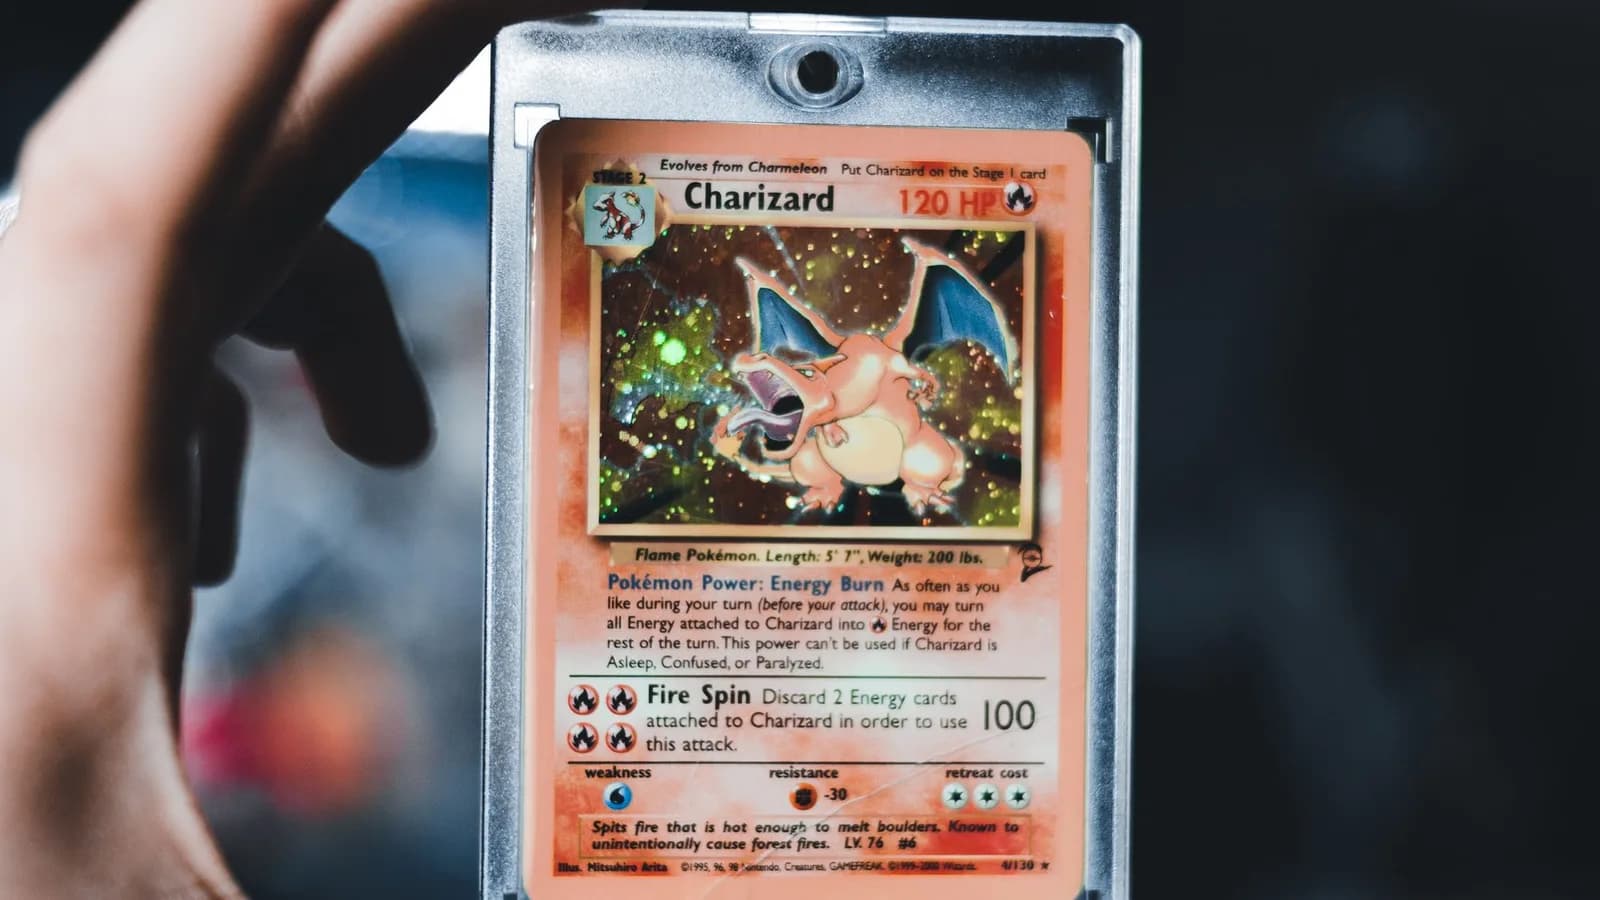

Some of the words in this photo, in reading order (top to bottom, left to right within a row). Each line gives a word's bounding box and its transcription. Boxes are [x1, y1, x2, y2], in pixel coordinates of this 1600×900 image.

[660, 159, 708, 173] Evolves
[712, 159, 743, 175] from
[748, 161, 827, 175] Charmeleon
[842, 164, 862, 176] Put
[866, 164, 924, 178] Charizard
[929, 169, 945, 178] on
[949, 165, 968, 179] the
[972, 167, 1004, 182] Stage
[1020, 168, 1046, 180] card
[592, 171, 633, 184] STAGE
[637, 172, 647, 184] 2
[684, 182, 834, 212] Charizard
[900, 190, 948, 216] 120
[960, 190, 996, 217] HP
[636, 548, 681, 563] Flame
[686, 548, 760, 563] Pokémon.
[765, 548, 820, 567] Length:
[868, 550, 922, 567] Weight:
[927, 550, 953, 565] 200
[958, 551, 983, 565] lbs.
[608, 574, 693, 591] Pokémon
[702, 575, 764, 591] Power:
[771, 576, 832, 596] Energy
[841, 576, 884, 592] Burn
[892, 581, 910, 593] As
[915, 580, 952, 594] often
[956, 584, 971, 594] as
[975, 585, 1000, 598] you
[608, 597, 631, 610] like
[636, 597, 681, 614] during
[686, 601, 717, 615] your
[723, 600, 752, 610] turn
[758, 597, 803, 615] (before
[807, 602, 835, 615] your
[840, 598, 889, 615] attack),
[893, 602, 918, 617] you
[922, 603, 949, 617] may
[956, 600, 984, 612] turn
[607, 617, 621, 630] all
[628, 618, 675, 634] Energy
[680, 617, 740, 630] attached
[745, 620, 759, 630] to
[765, 618, 833, 631] Charizard
[838, 618, 865, 631] into
[892, 619, 938, 636] Energy
[943, 618, 963, 632] for
[969, 620, 991, 632] the
[607, 639, 633, 649] rest
[639, 637, 654, 649] of
[658, 637, 681, 649] the
[686, 639, 717, 650] turn.
[722, 637, 751, 650] This
[755, 641, 800, 655] power
[805, 637, 838, 651] can't
[843, 637, 861, 651] be
[864, 638, 896, 651] used
[902, 638, 912, 651] if
[915, 638, 981, 652] Charizard
[987, 639, 997, 652] is
[607, 657, 657, 673] Asleep,
[661, 656, 731, 671] Confused,
[734, 660, 749, 670] or
[756, 657, 824, 674] Paralyzed.
[647, 685, 689, 705] Fire
[702, 685, 751, 709] Spin
[763, 689, 825, 705] Discard
[833, 690, 842, 705] 2
[850, 690, 906, 709] Energy
[913, 691, 957, 706] cards
[646, 712, 717, 729] attached
[725, 715, 744, 729] to
[750, 713, 832, 729] Charizard
[839, 714, 853, 729] in
[860, 713, 909, 730] order
[914, 716, 932, 730] to
[939, 719, 968, 730] use
[983, 699, 1036, 731] 100
[646, 736, 676, 752] this
[682, 737, 737, 752] attack.
[585, 767, 651, 779] weakness
[769, 767, 838, 780] resistance
[945, 767, 994, 780] retreat
[999, 768, 1028, 780] cost
[823, 788, 848, 801] -30
[592, 821, 626, 836] Spits
[635, 821, 658, 835] fire
[667, 821, 696, 833] that
[705, 821, 715, 833] is
[723, 821, 747, 833] hot
[755, 821, 806, 835] enough
[815, 822, 829, 833] to
[838, 821, 869, 833] melt
[878, 821, 940, 833] boulders.
[948, 821, 996, 832] Known
[1004, 821, 1019, 832] to
[592, 838, 700, 853] unintentionally
[706, 840, 746, 849] cause
[752, 838, 791, 851] forest
[796, 837, 830, 851] fires.
[844, 837, 862, 849] LV.
[867, 837, 883, 849] 76
[898, 837, 916, 849] #6
[587, 863, 637, 872] Mitsuhiro
[642, 862, 668, 872] Arita
[728, 863, 738, 872] 98
[1001, 860, 1034, 871] 4/130
